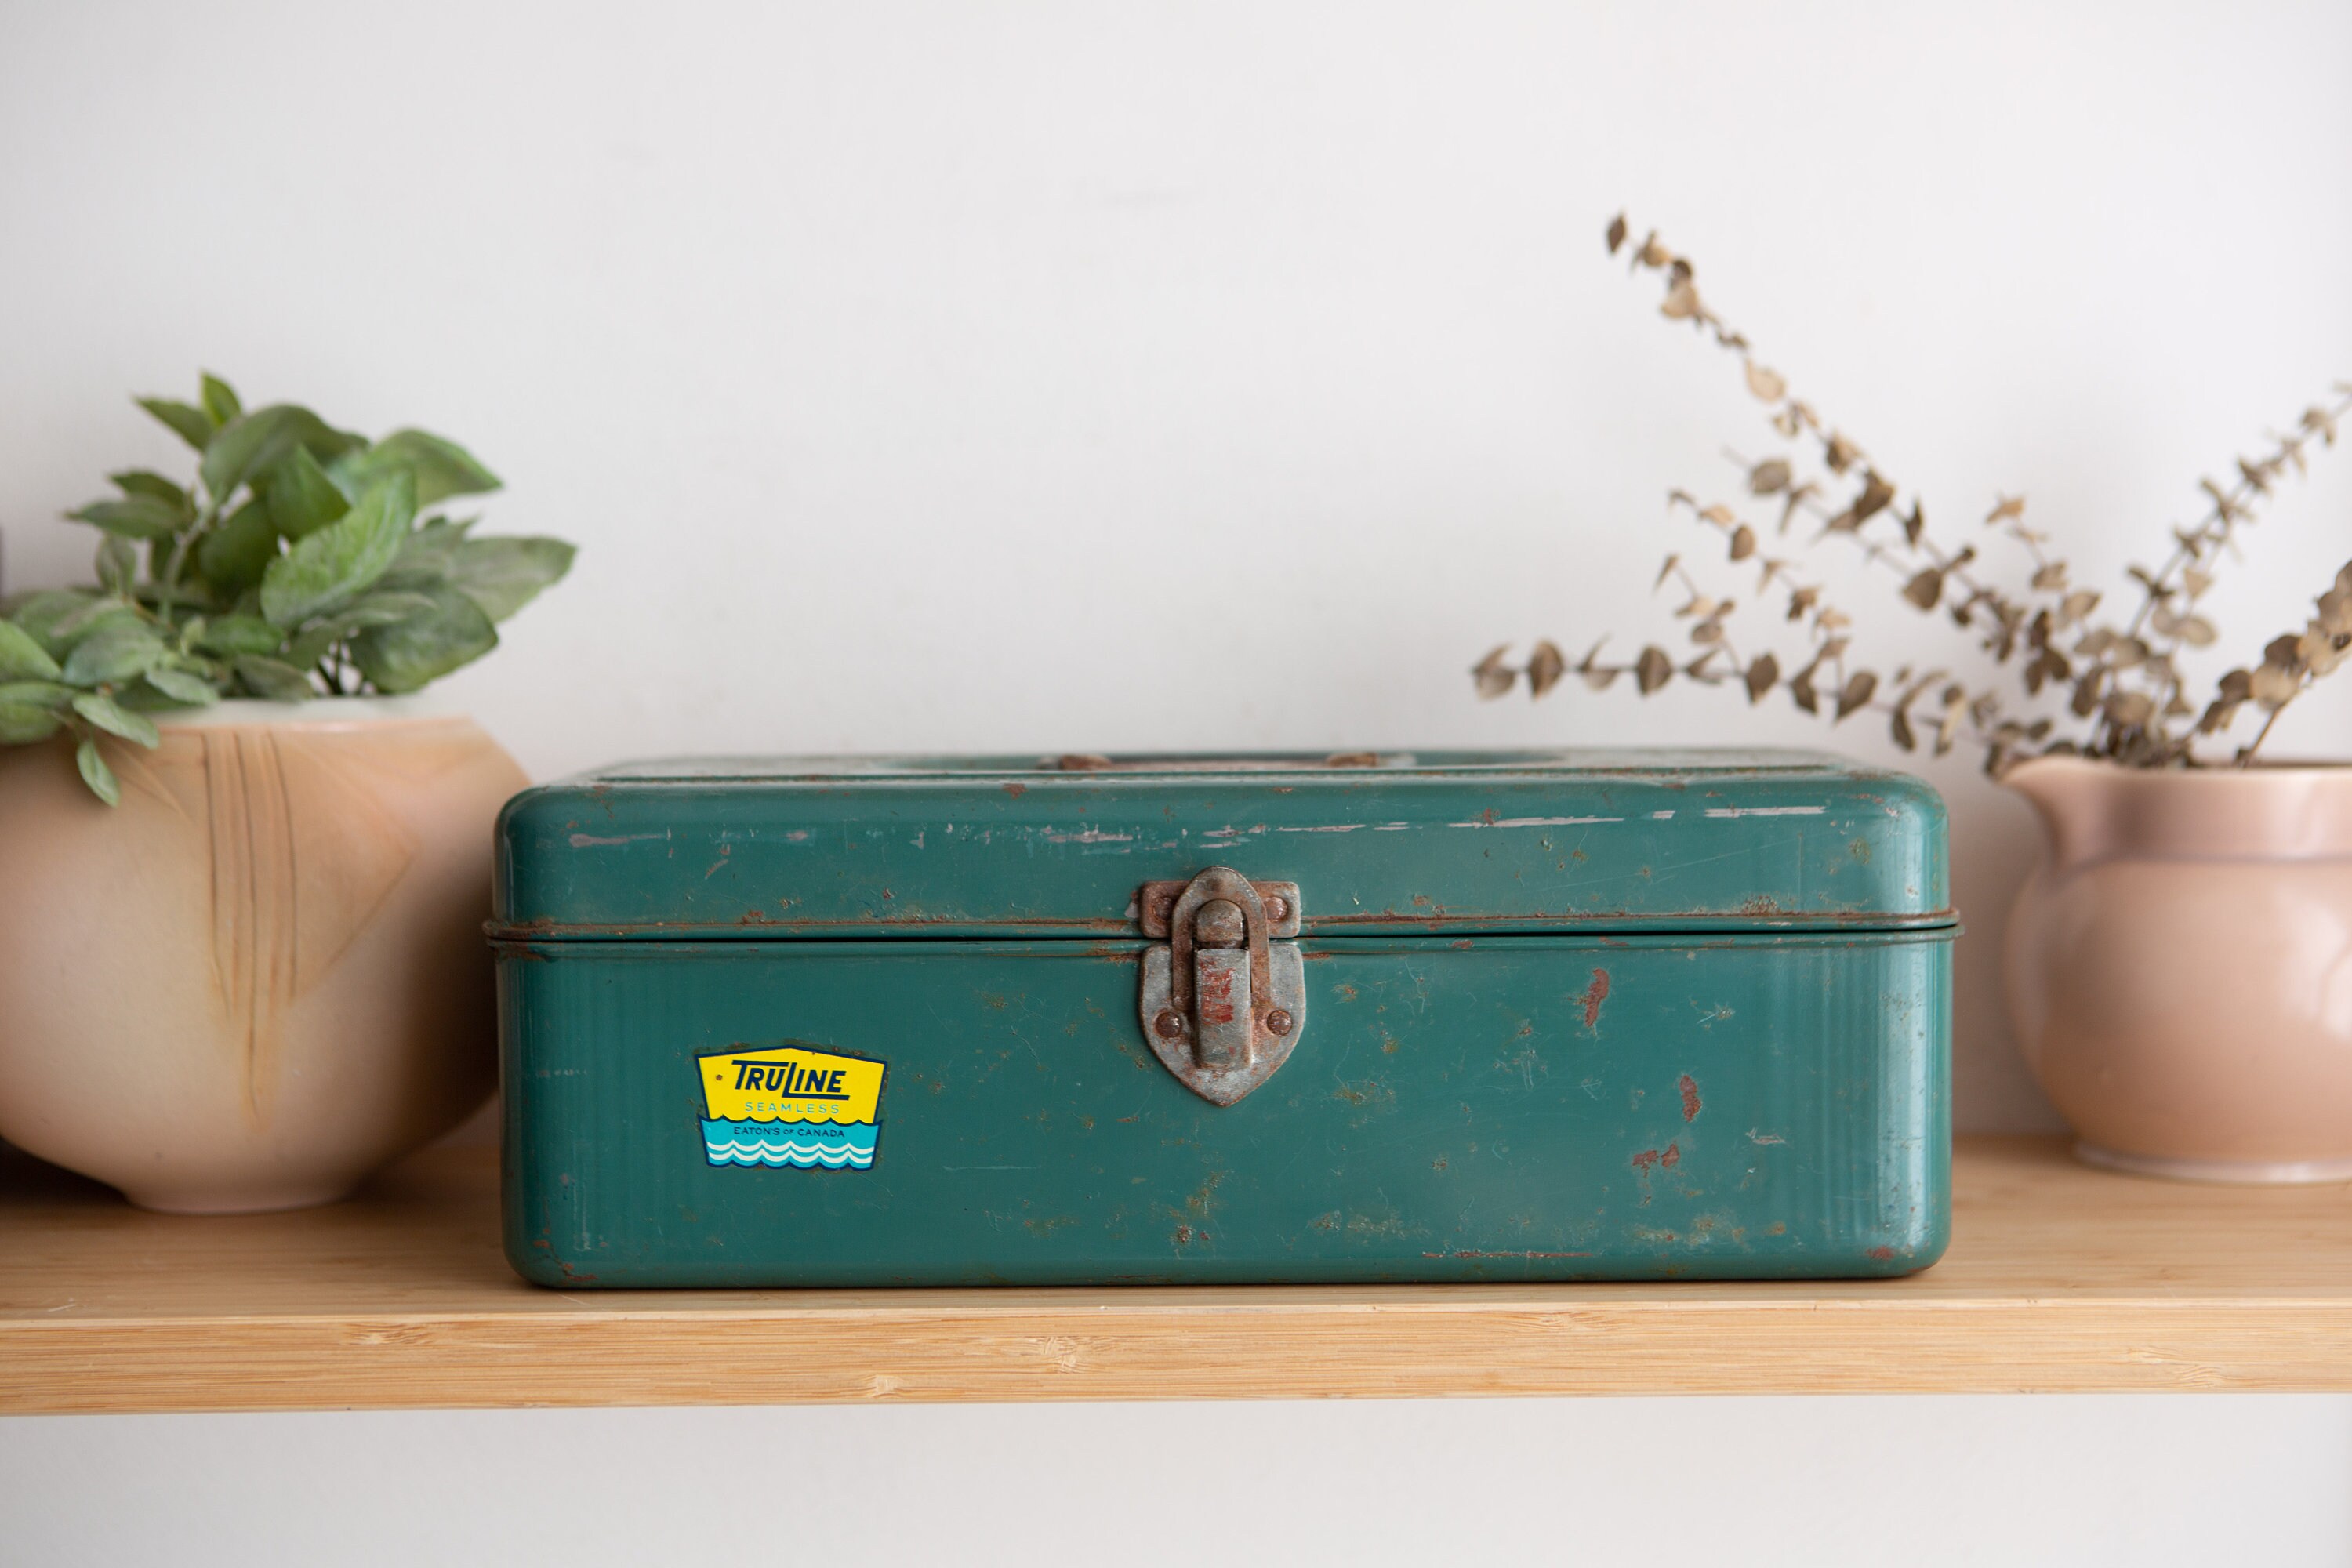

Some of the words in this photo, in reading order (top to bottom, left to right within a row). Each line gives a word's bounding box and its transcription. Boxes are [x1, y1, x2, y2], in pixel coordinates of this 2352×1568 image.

[731, 1060, 850, 1100] TRULINE
[745, 1102, 839, 1113] SEAMLESS
[734, 1127, 780, 1135] EATON'S
